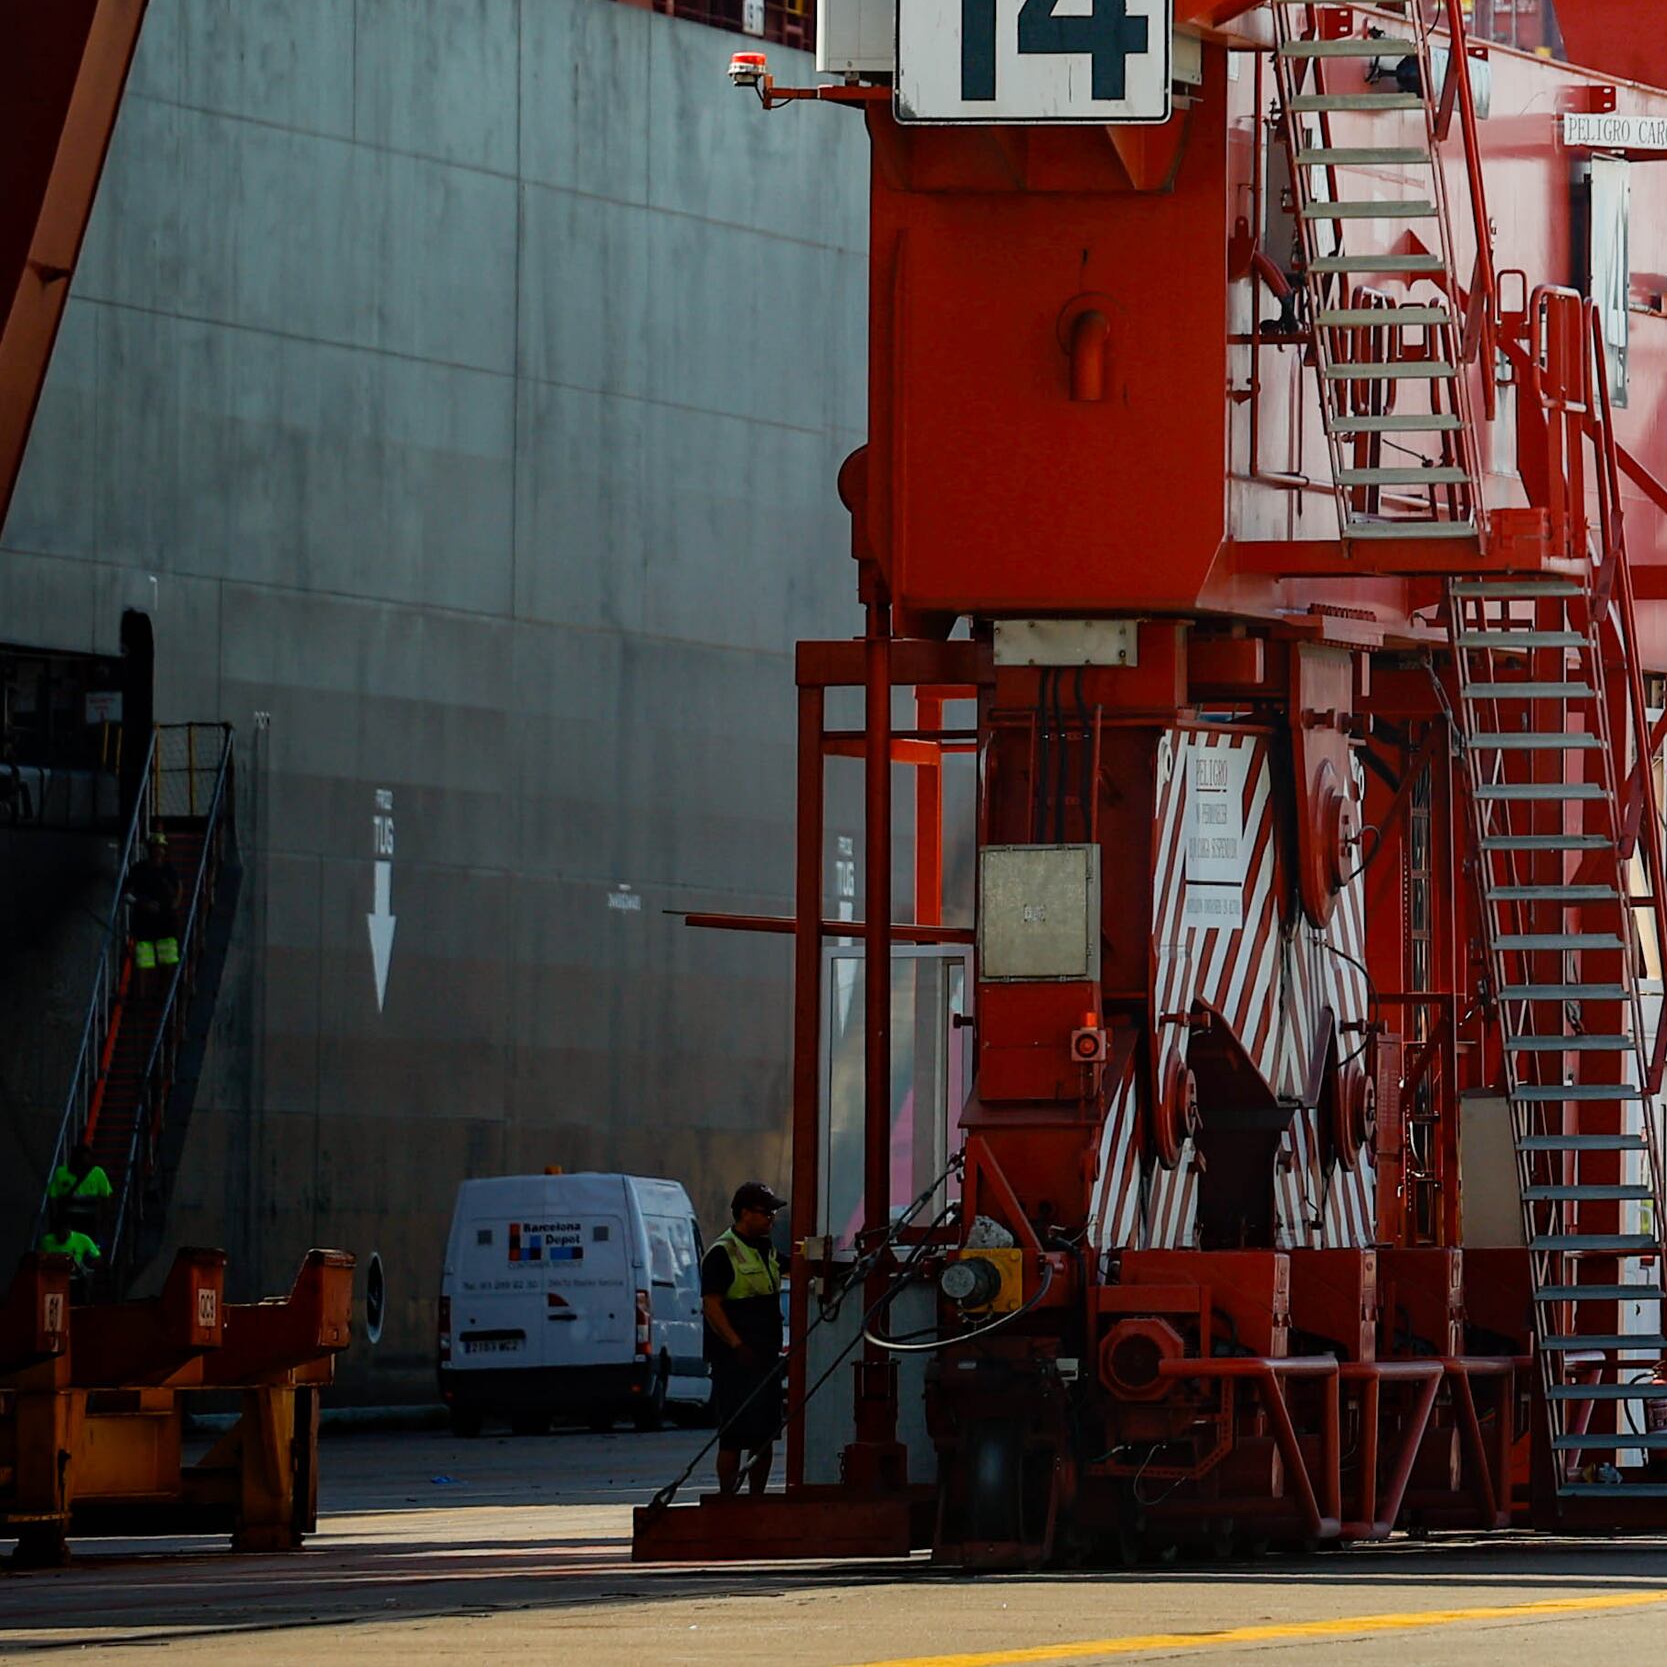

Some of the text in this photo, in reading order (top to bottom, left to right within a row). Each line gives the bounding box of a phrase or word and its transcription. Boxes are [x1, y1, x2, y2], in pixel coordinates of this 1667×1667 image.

[1567, 116, 1632, 146] PELIGRO
[523, 1222, 582, 1233] Barcelona
[545, 1234, 580, 1246] Depot
